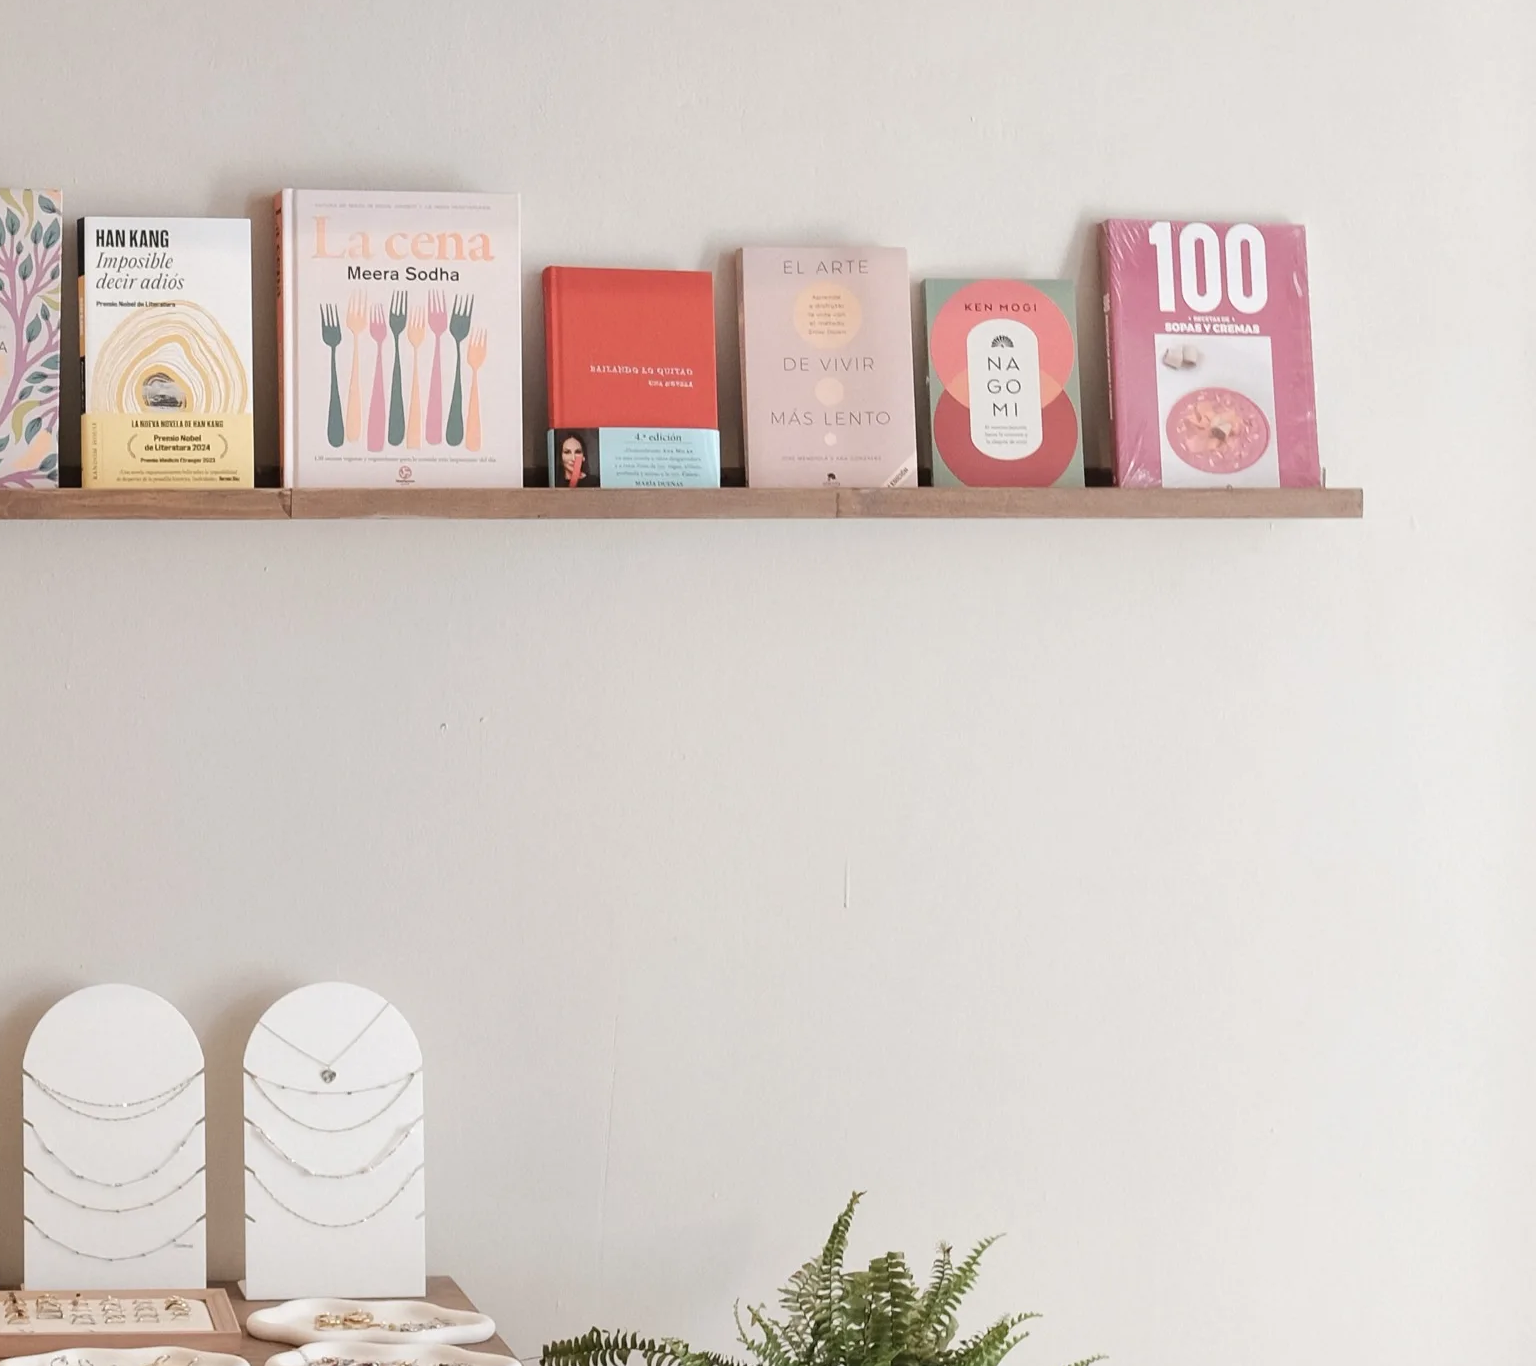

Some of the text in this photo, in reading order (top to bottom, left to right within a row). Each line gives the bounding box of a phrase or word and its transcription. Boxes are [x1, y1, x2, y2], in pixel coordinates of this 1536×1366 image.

[95, 229, 169, 248] HAN KANG
[312, 215, 495, 262] La cena
[95, 251, 174, 272] Imposible
[783, 260, 869, 274] EL ARTE
[1148, 221, 1269, 315] 100
[95, 271, 185, 291] decir adiós
[347, 266, 460, 282] Meera Sodha
[964, 304, 1038, 313] KEN MOGI
[783, 357, 875, 372] DE VIVIR
[987, 357, 1020, 371] NA
[986, 380, 1022, 394] GO
[771, 408, 891, 426] MÁS LENTO
[992, 403, 1019, 417] MI
[131, 420, 224, 428] LA NUEVA NOVELA DE HAN KANG
